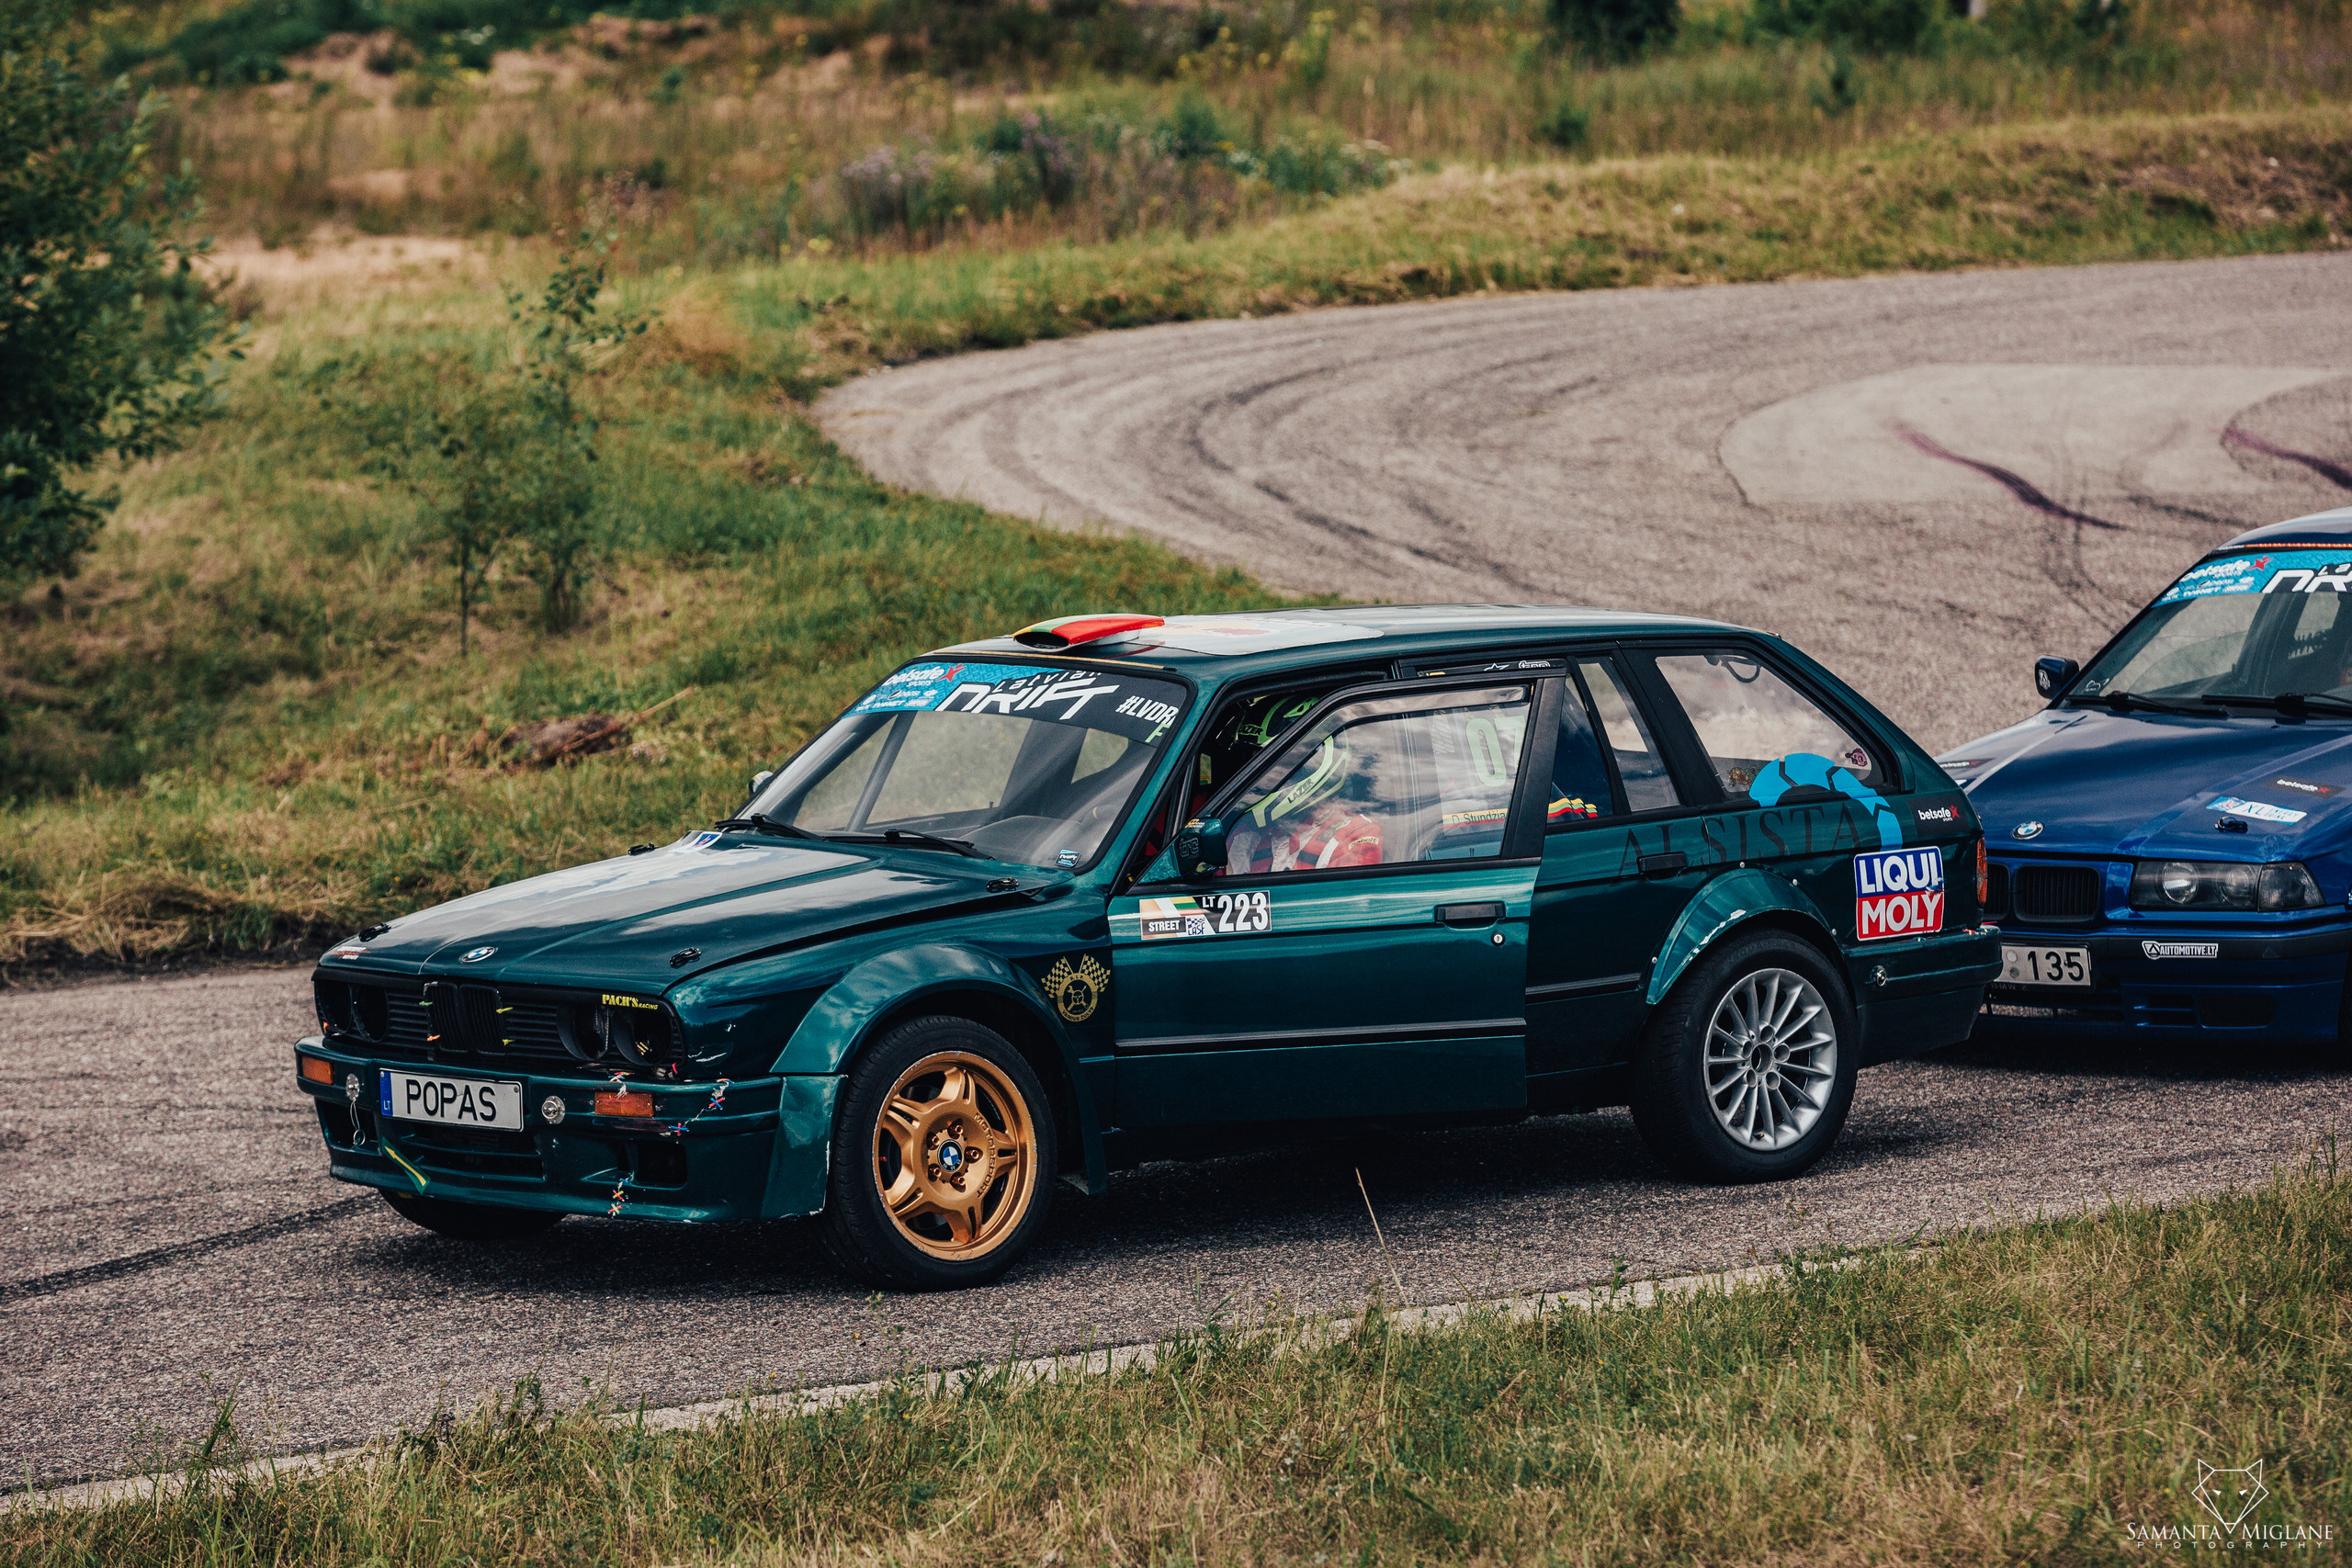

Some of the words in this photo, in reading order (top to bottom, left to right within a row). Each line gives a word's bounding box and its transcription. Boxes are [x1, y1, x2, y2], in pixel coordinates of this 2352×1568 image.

[935, 678, 1120, 721] DRIFT
[1115, 695, 1180, 726] #LVDR
[1287, 778, 1314, 804] LAZER
[1918, 807, 1951, 820] betsafe
[1859, 852, 1939, 894] LIQUI
[1148, 920, 1180, 931] STREET
[1202, 896, 1216, 908] LT
[1217, 892, 1268, 932] 223
[1861, 893, 1941, 934] MOLY
[2027, 950, 2085, 981] 135
[2159, 945, 2216, 955] AUTOMOTIVE.LT
[602, 994, 639, 1008] PACH'S
[383, 1100, 390, 1111] LT
[405, 1078, 497, 1122] POPAS
[973, 1112, 996, 1199] MOTORSPORT
